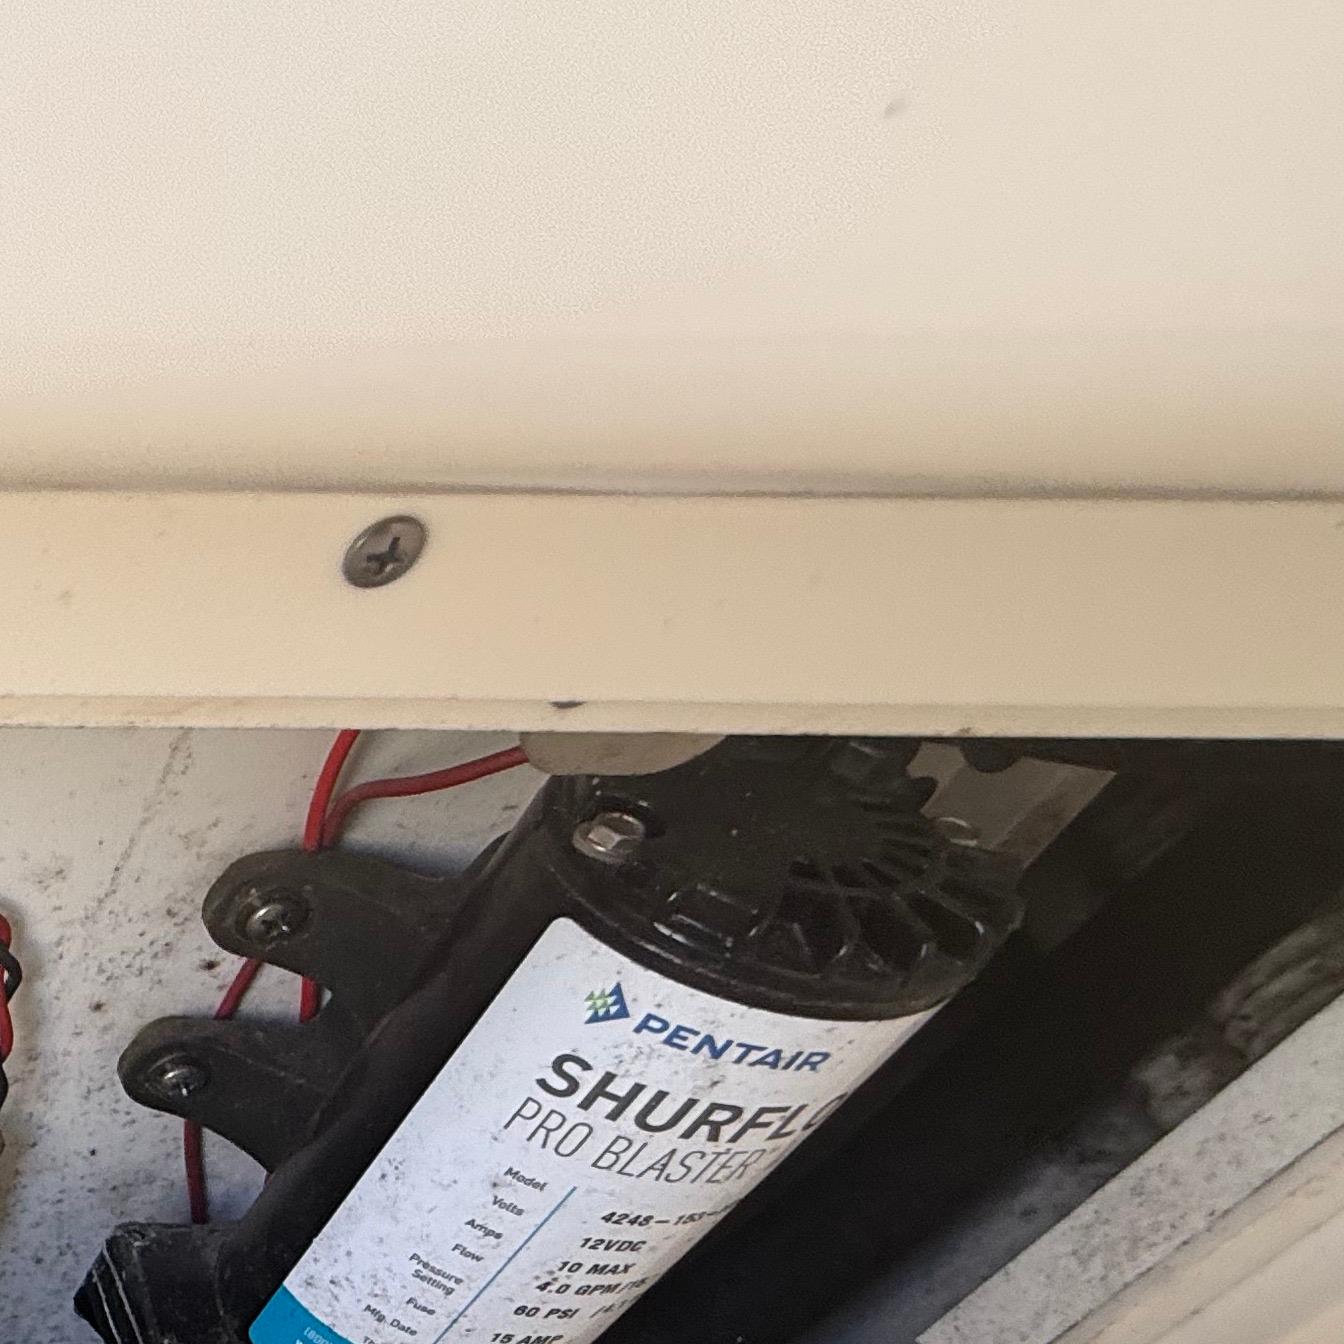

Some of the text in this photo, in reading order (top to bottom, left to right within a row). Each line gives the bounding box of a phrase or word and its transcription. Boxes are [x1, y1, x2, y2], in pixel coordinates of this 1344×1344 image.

[633, 1013, 830, 1071] PENTAIR
[503, 1097, 762, 1184] PRO BLASTER
[504, 1166, 547, 1192] Model
[465, 1218, 637, 1275] Amps 10 MAX
[492, 1195, 647, 1252] Volts 12VDC
[409, 1253, 464, 1286] Pressure
[411, 1269, 455, 1297] Setting
[513, 1305, 542, 1318] 60
[547, 1307, 586, 1320] PSI
[451, 1243, 485, 1263] Flow
[535, 1281, 570, 1295] 4.0
[574, 1283, 618, 1296] GPM
[389, 1318, 418, 1337] Date
[406, 1296, 564, 1344] Fuse 15 AMP
